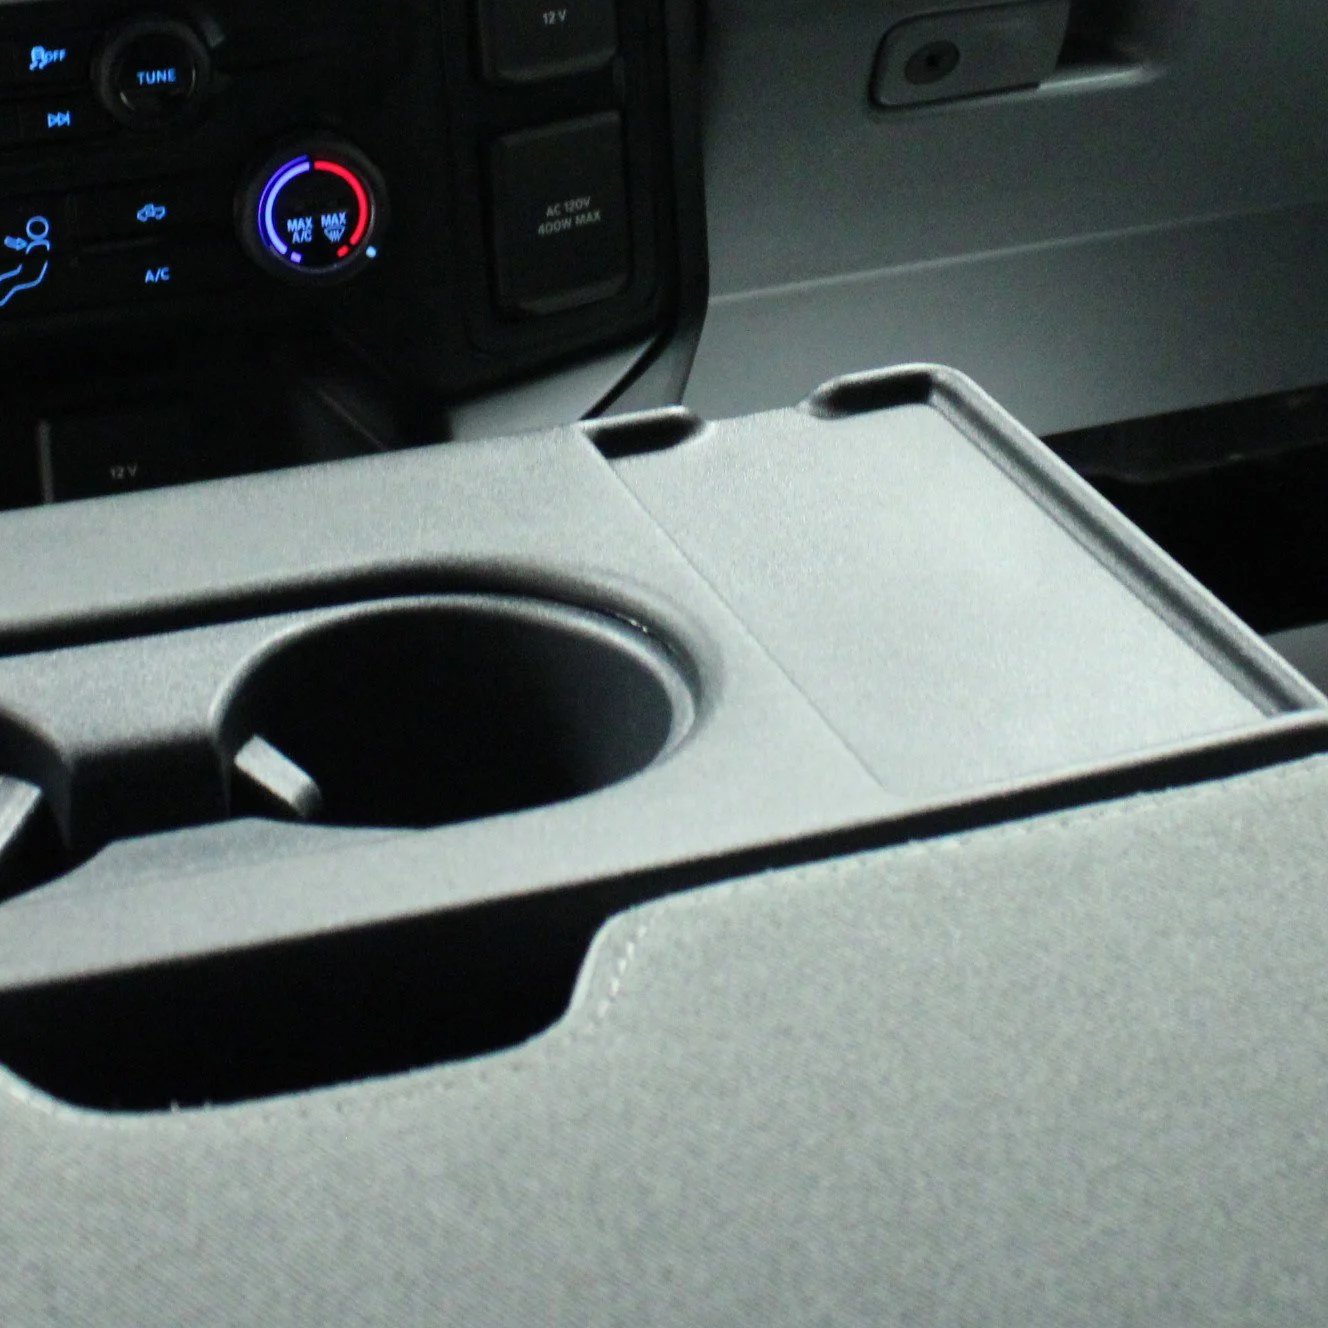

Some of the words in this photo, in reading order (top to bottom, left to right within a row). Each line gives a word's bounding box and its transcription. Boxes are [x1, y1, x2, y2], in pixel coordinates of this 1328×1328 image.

[137, 68, 176, 85] TUNE
[287, 216, 312, 232] MAX
[321, 211, 346, 228] MAX
[574, 208, 601, 227] MAX
[292, 230, 312, 244] A/C
[145, 266, 170, 284] A/C
